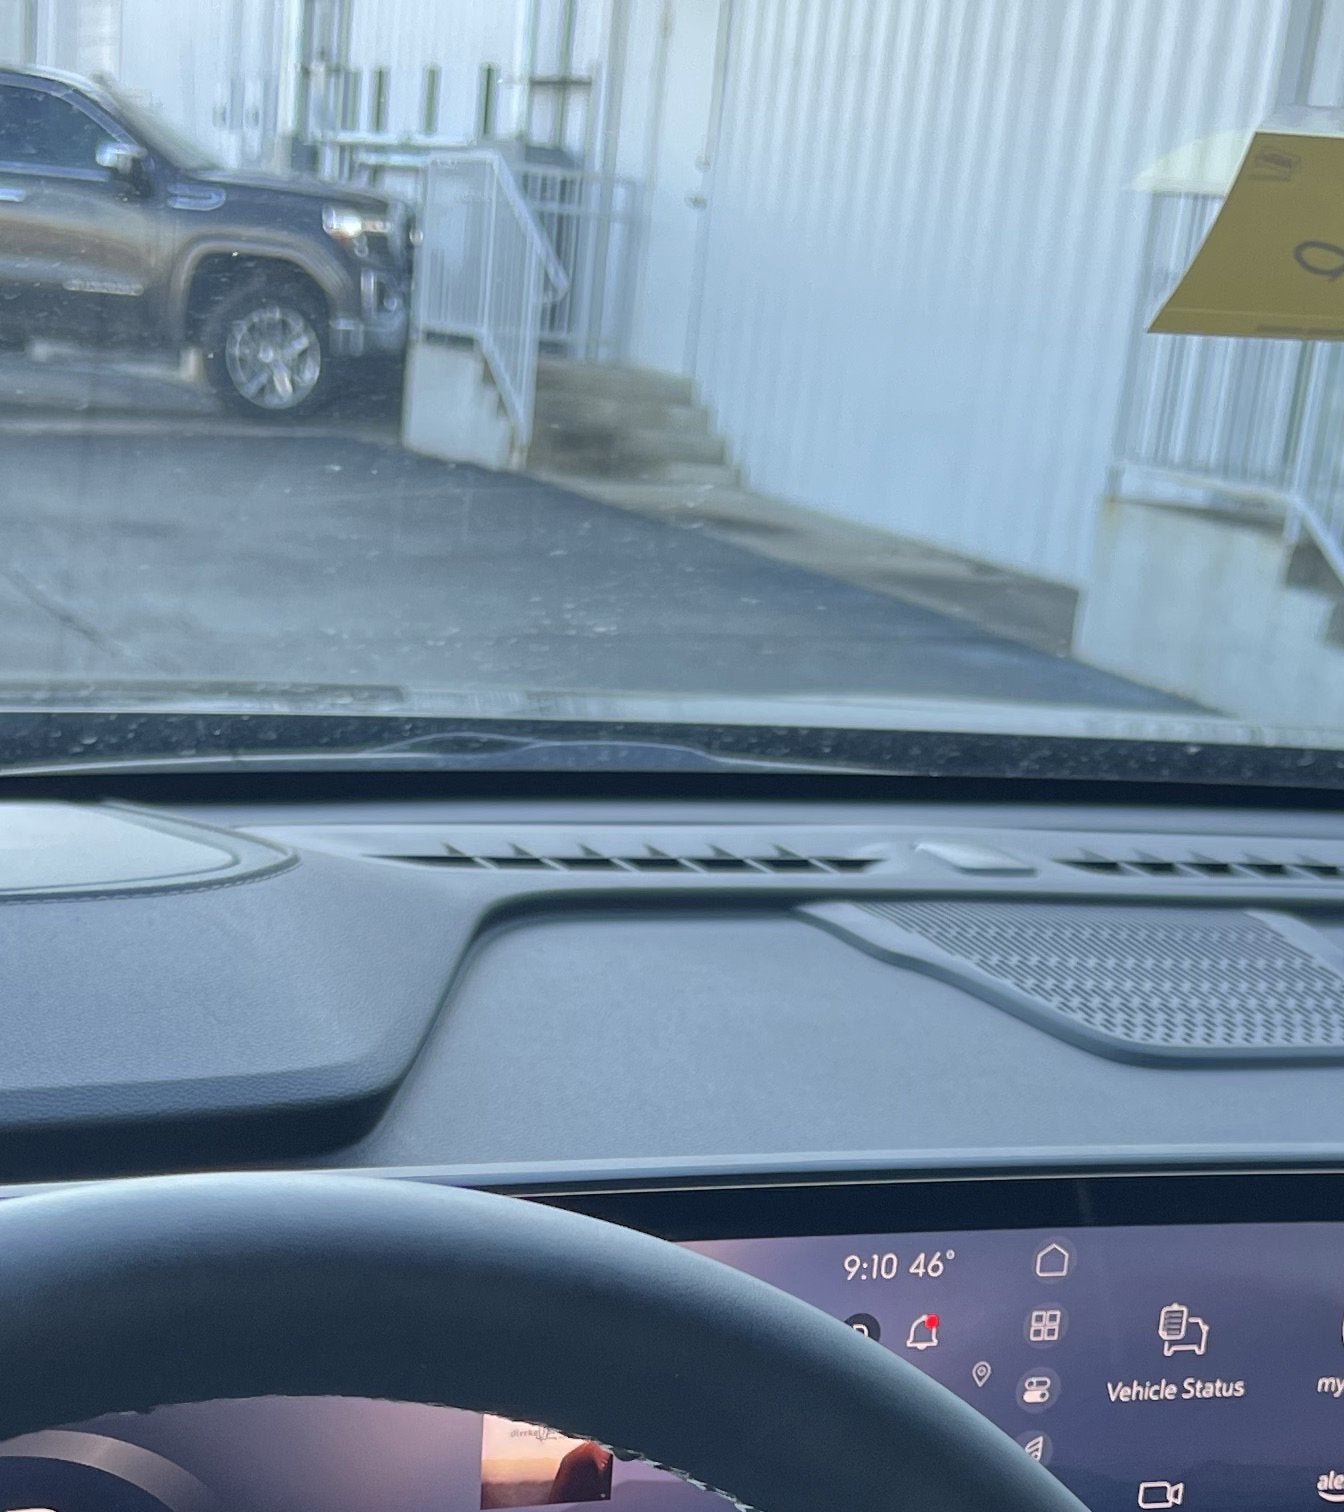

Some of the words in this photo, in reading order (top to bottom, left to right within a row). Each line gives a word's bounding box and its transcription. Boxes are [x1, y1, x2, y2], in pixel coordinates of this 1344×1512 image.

[843, 1252, 898, 1281] 9:10
[909, 1249, 955, 1278] 46°
[1106, 1378, 1177, 1402] Vehicle
[1182, 1376, 1245, 1400] Status
